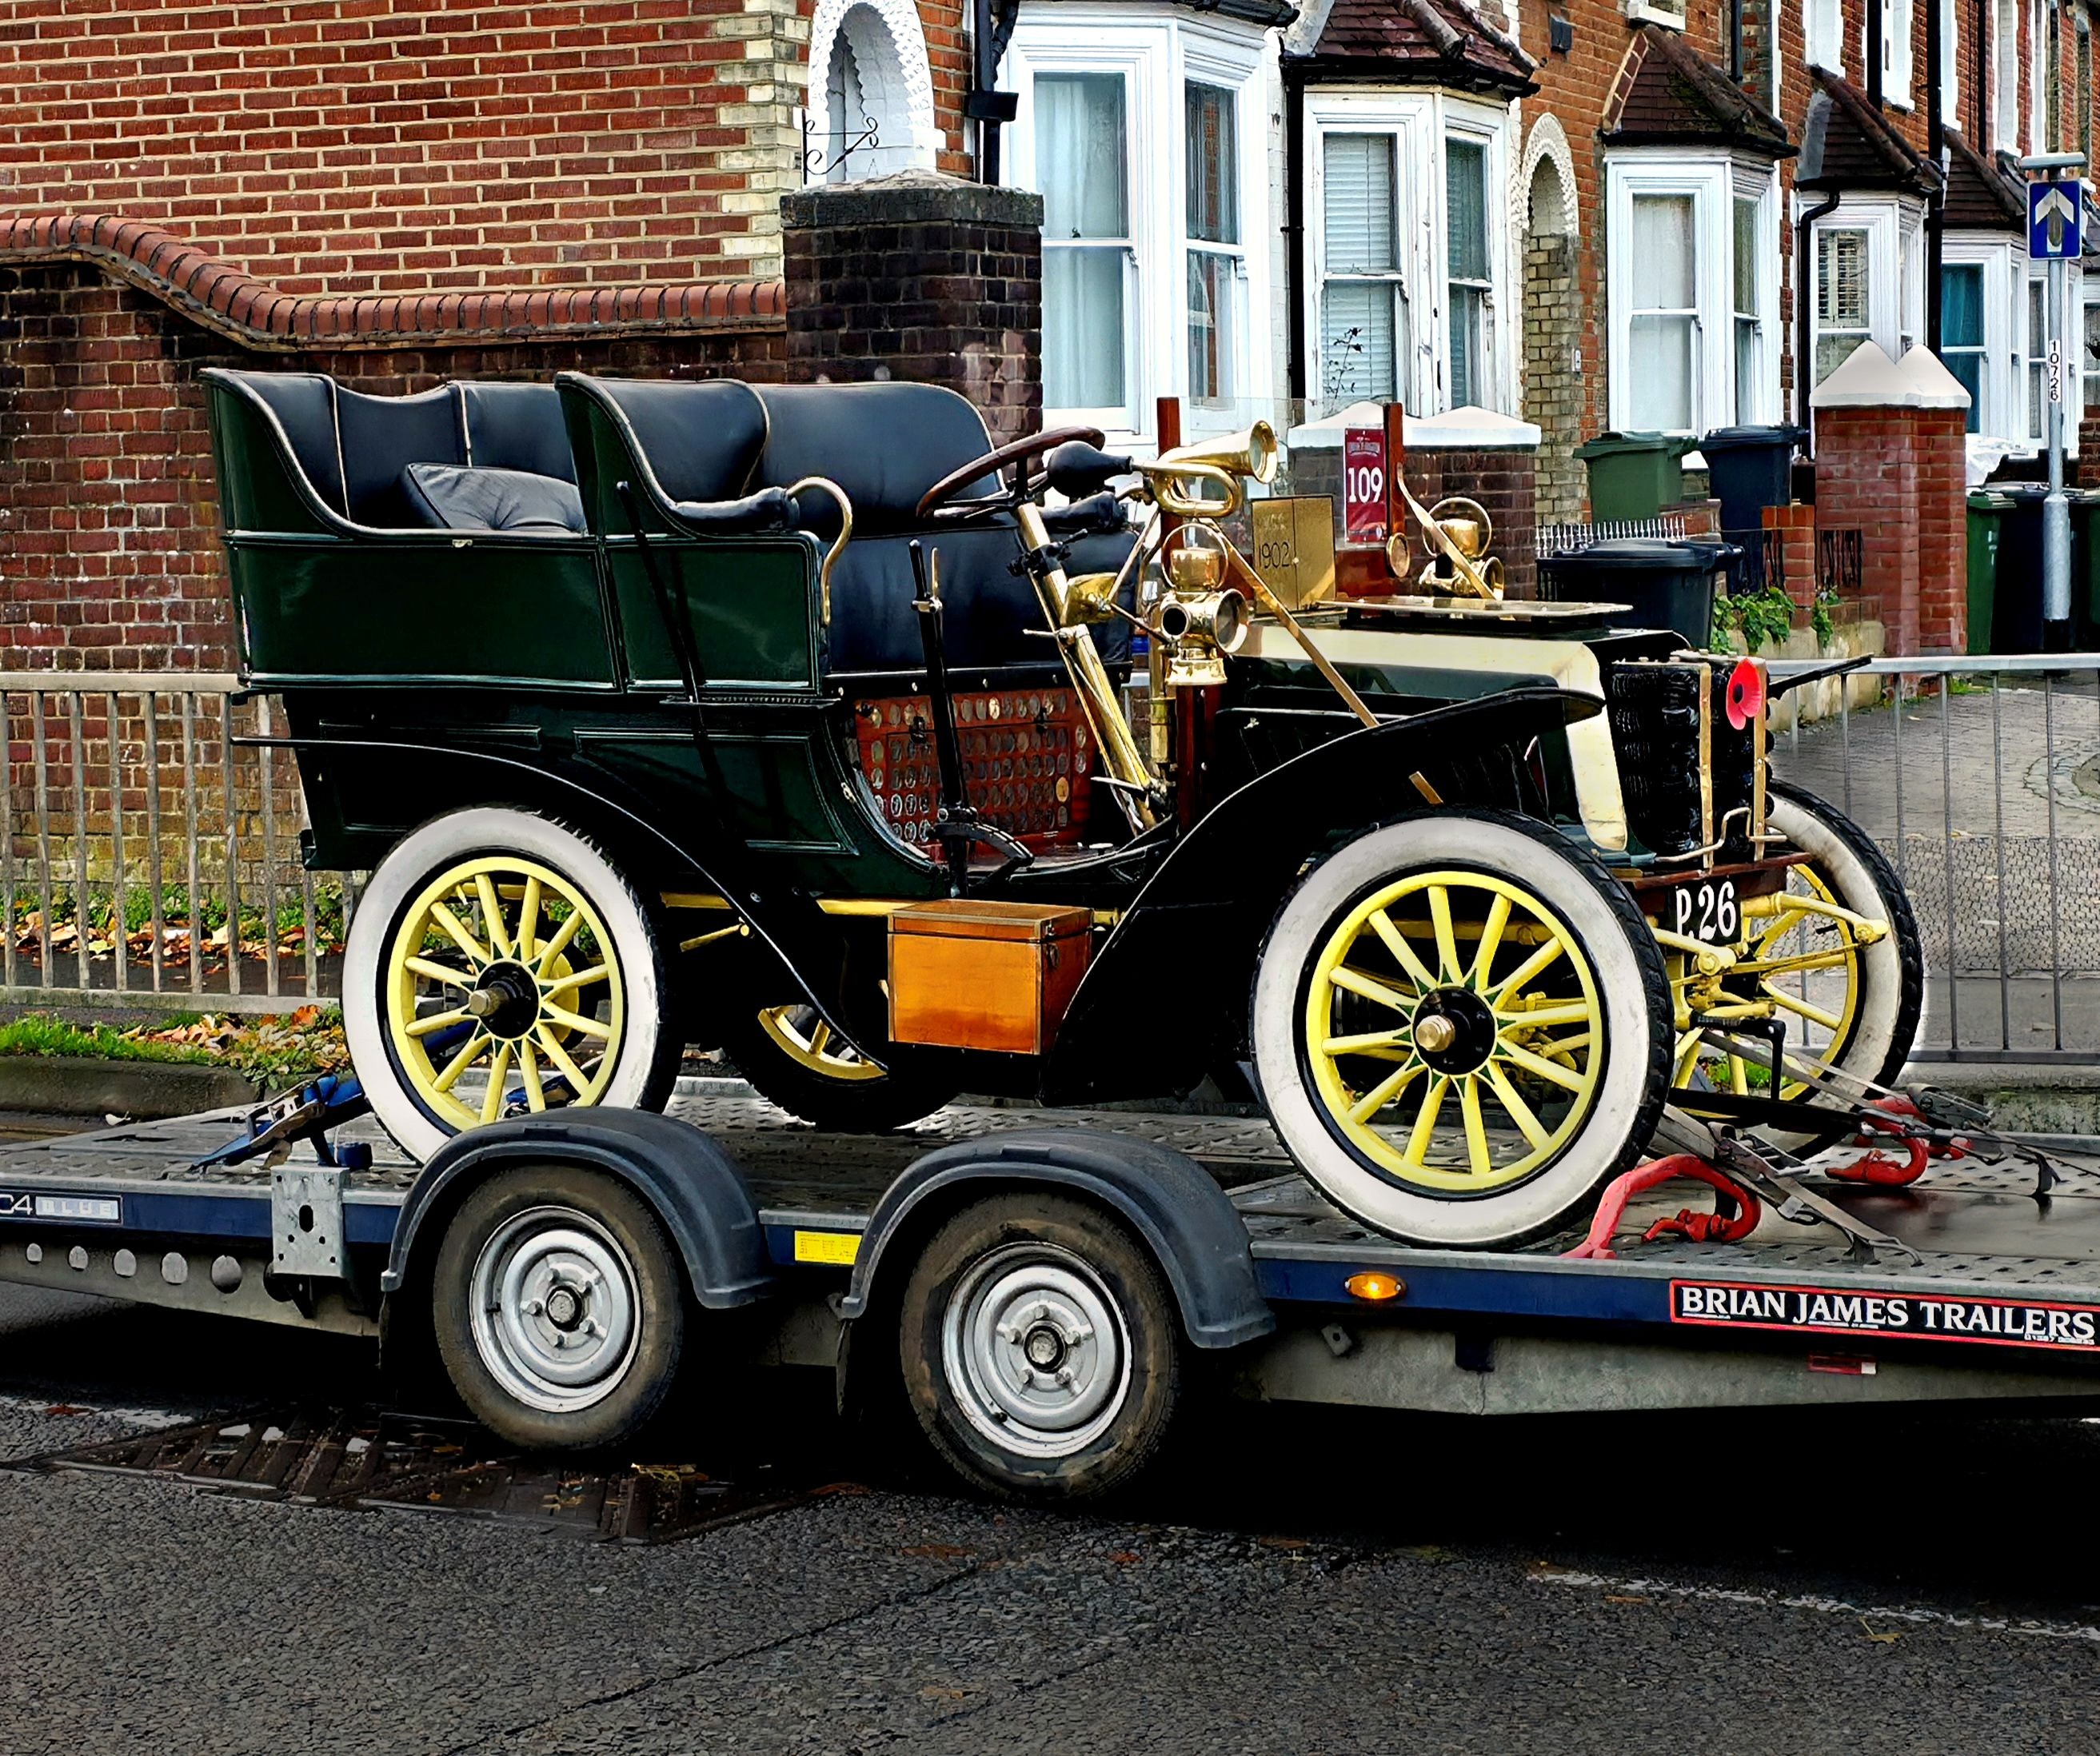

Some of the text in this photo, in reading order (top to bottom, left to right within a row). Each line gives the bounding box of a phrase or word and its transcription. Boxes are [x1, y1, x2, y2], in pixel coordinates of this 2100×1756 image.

[2050, 340, 2059, 401] 10726
[1347, 466, 1383, 503] 109
[1259, 541, 1290, 569] 1902
[42, 1199, 112, 1216] BLUE
[1682, 1287, 2095, 1340] BRIAN JAMES TRAILERS
